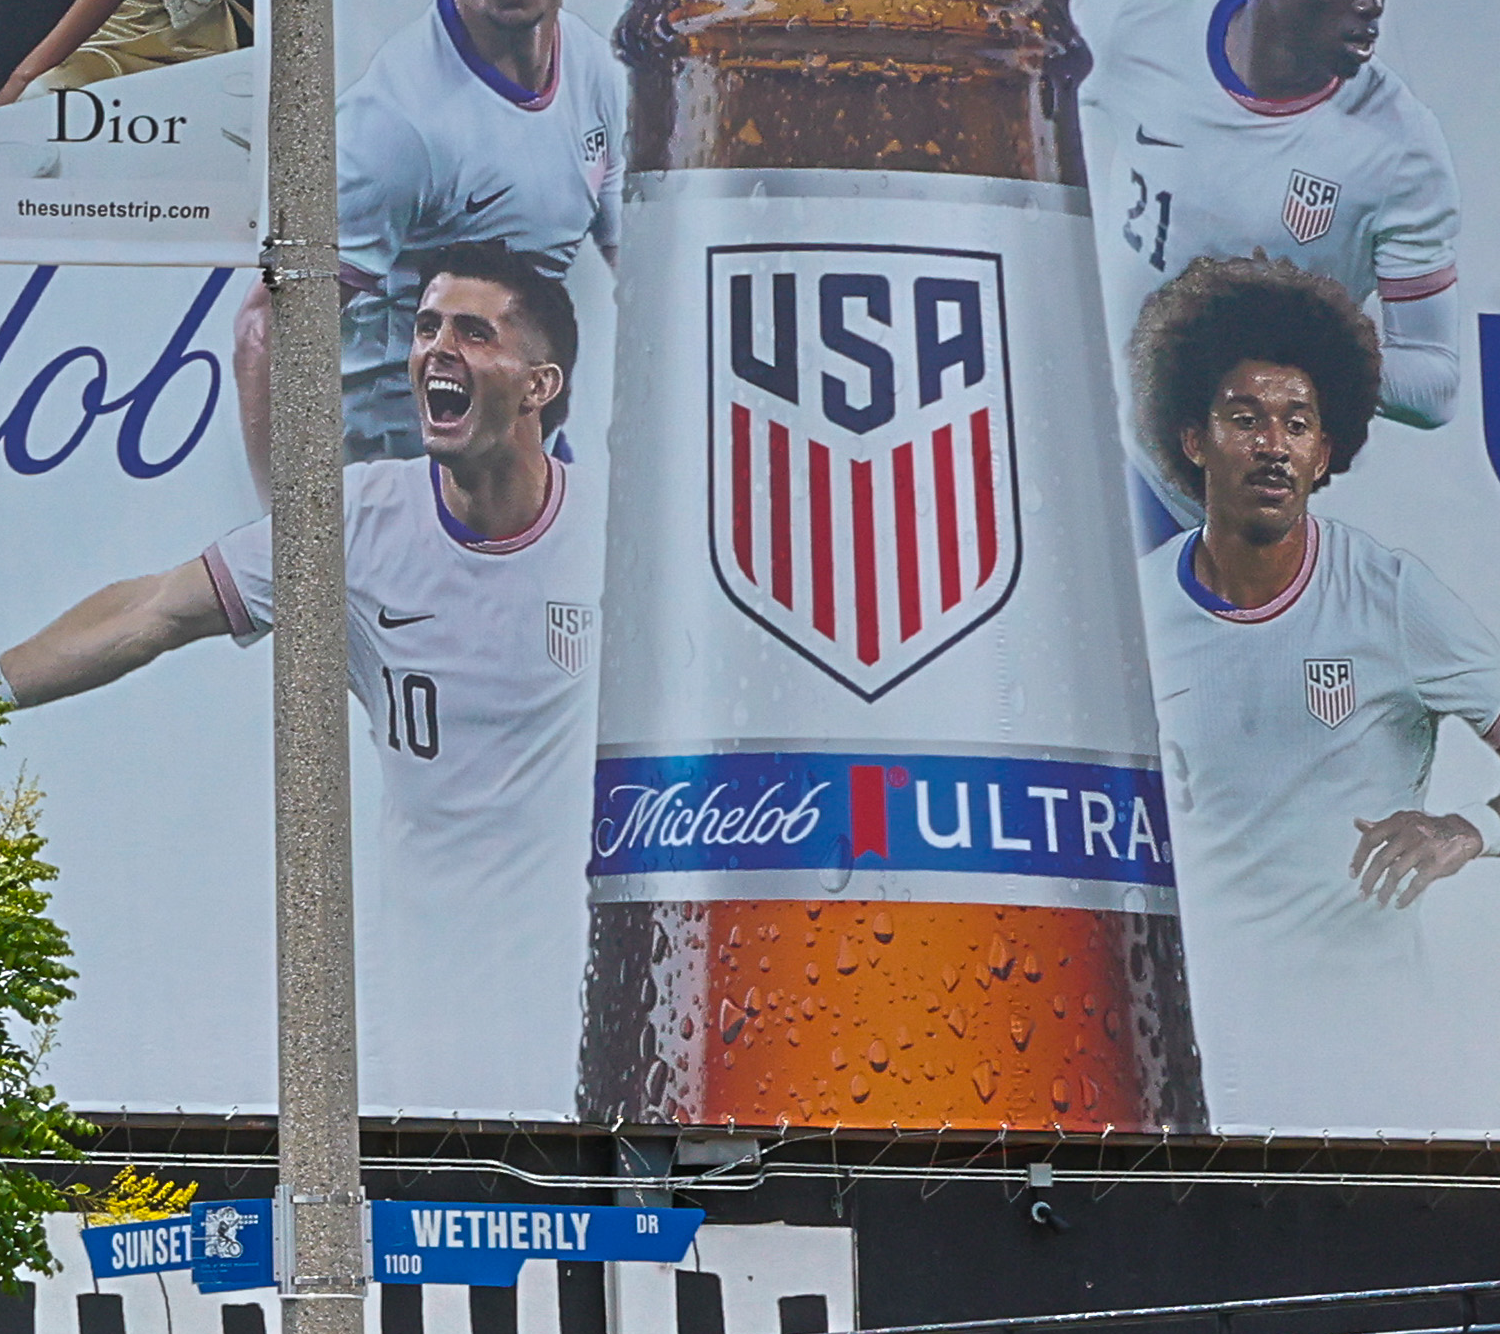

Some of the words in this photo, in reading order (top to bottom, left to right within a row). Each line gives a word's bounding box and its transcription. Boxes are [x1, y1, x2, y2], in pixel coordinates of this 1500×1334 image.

[47, 88, 188, 145] Dior
[17, 198, 211, 222] thesunsetstrip.com
[1291, 171, 1337, 209] USA
[1123, 167, 1174, 273] 21
[730, 272, 986, 436] USA
[550, 603, 595, 634] USA
[1308, 662, 1350, 690] USA
[382, 666, 440, 763] 10
[596, 780, 832, 859] Michelob
[914, 779, 1160, 864] ULTRA
[111, 1223, 192, 1269] SUNSET
[411, 1209, 591, 1252] WETHERLY
[635, 1213, 659, 1236] DR
[384, 1254, 423, 1276] 1100
